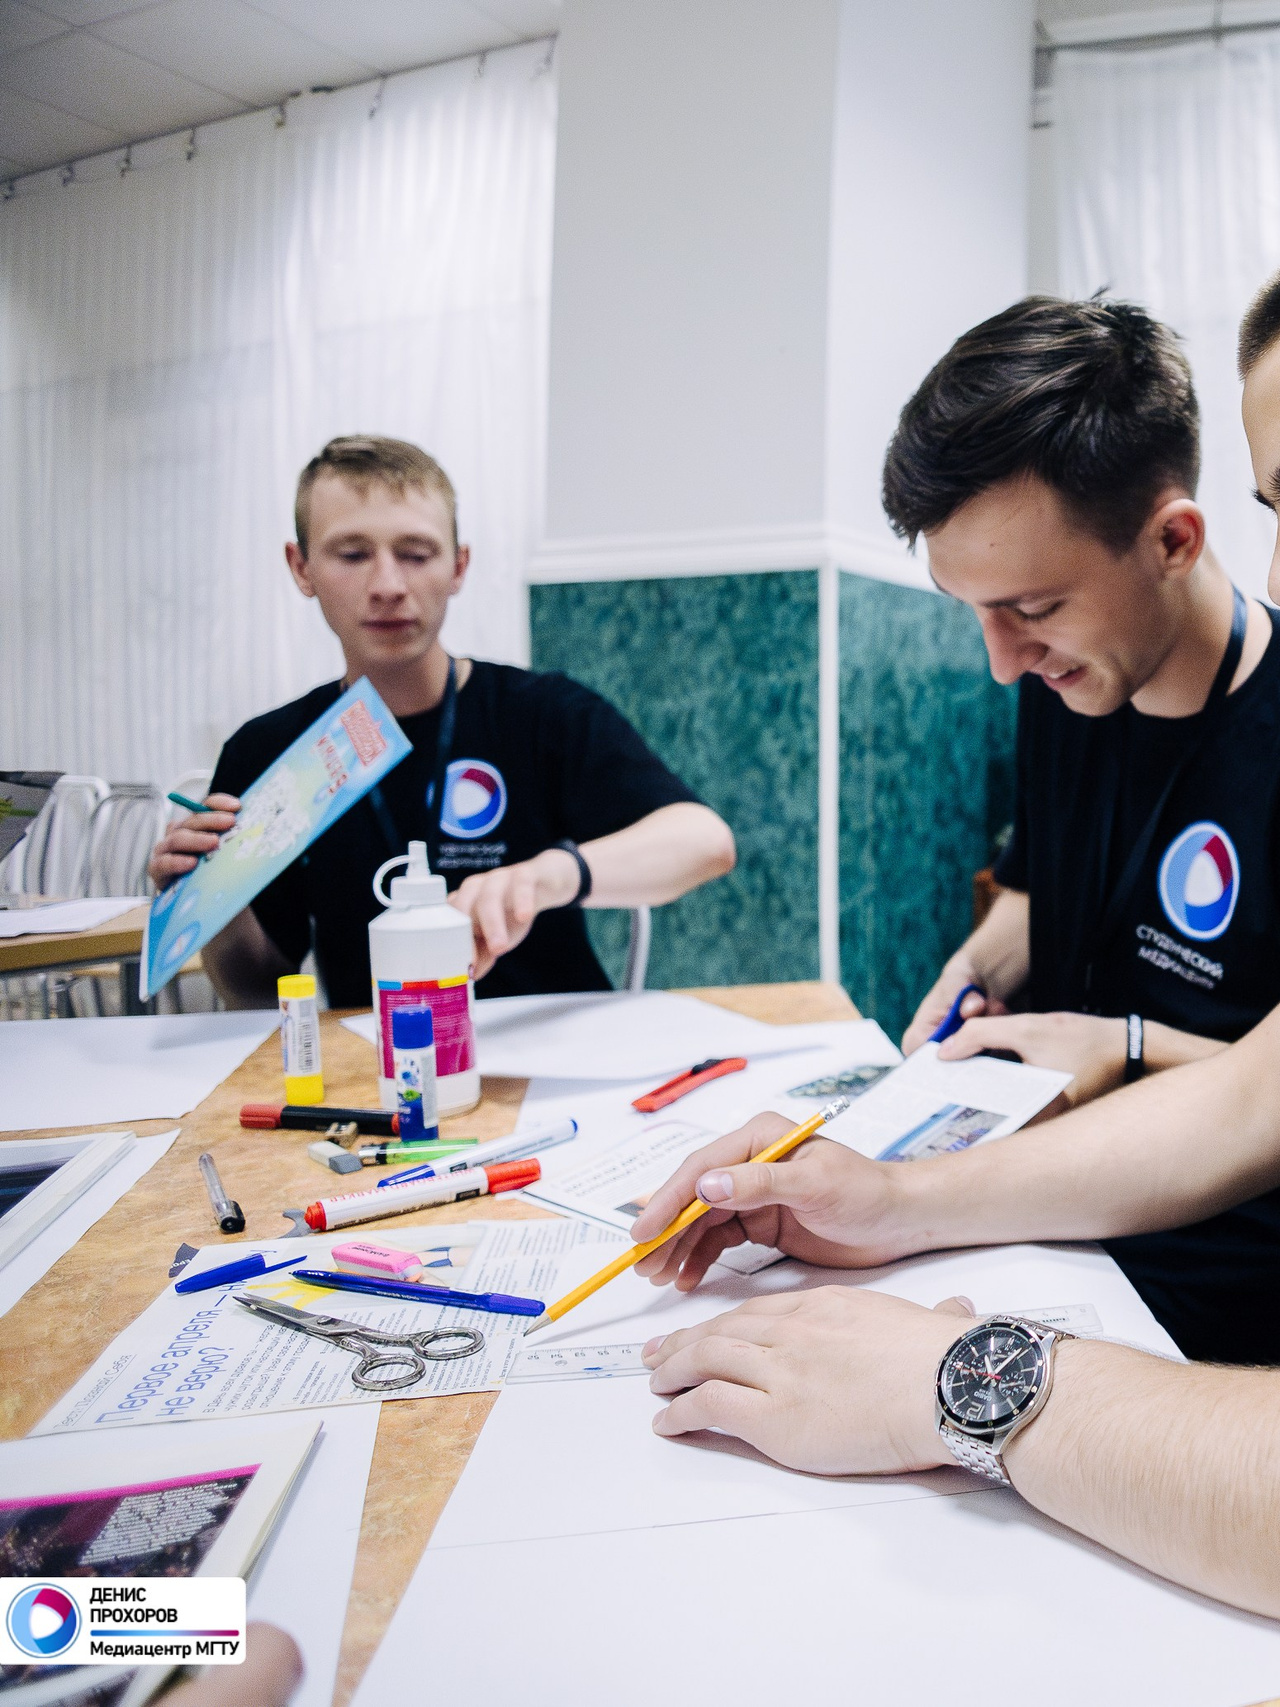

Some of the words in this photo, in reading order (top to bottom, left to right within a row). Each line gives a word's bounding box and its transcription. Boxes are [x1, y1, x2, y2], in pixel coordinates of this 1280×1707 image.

[96, 1362, 179, 1423] Первое
[161, 1310, 223, 1358] апреля
[155, 1396, 196, 1416] не
[176, 1347, 234, 1392] верю?
